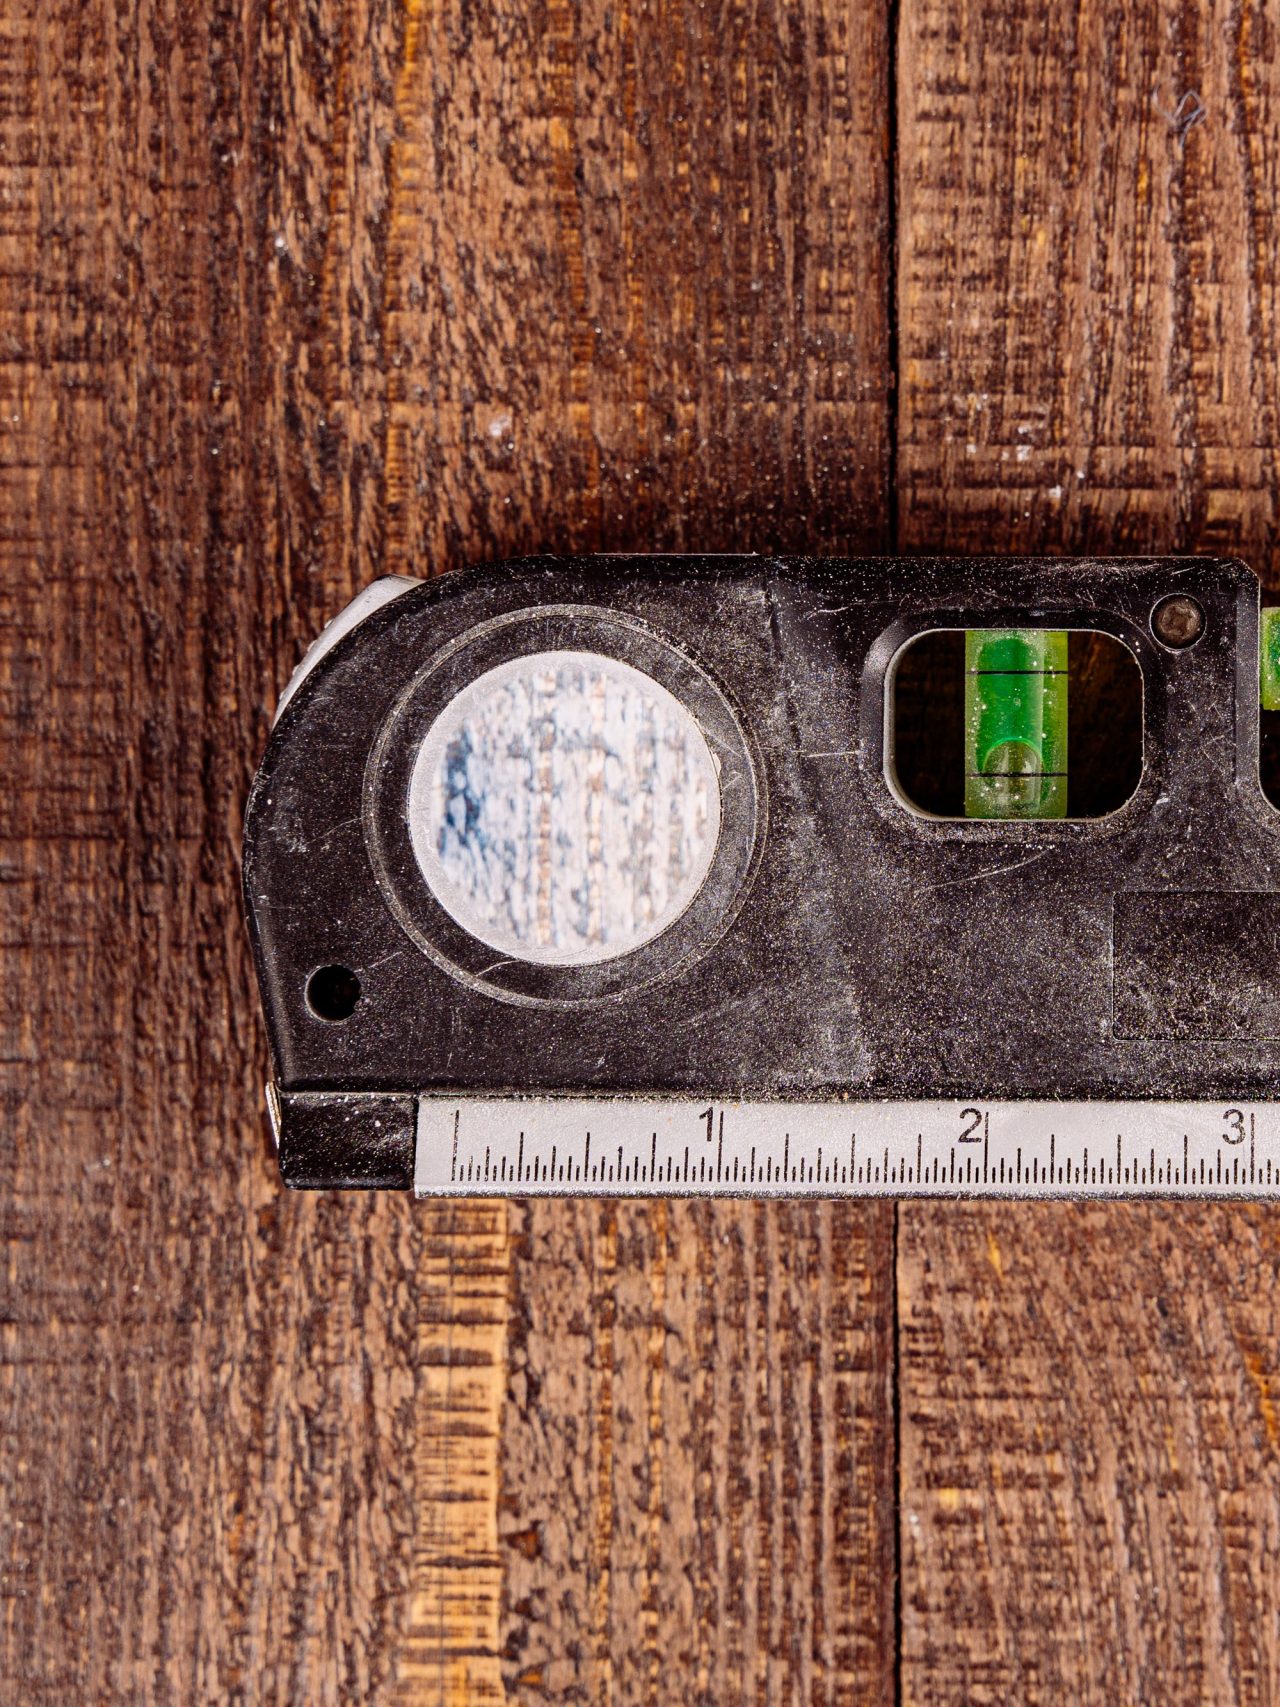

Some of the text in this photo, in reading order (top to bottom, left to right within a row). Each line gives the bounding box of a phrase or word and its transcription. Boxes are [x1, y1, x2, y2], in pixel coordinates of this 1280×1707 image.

[699, 1106, 714, 1142] 1
[958, 1107, 983, 1143] 2
[1222, 1108, 1246, 1145] 3
